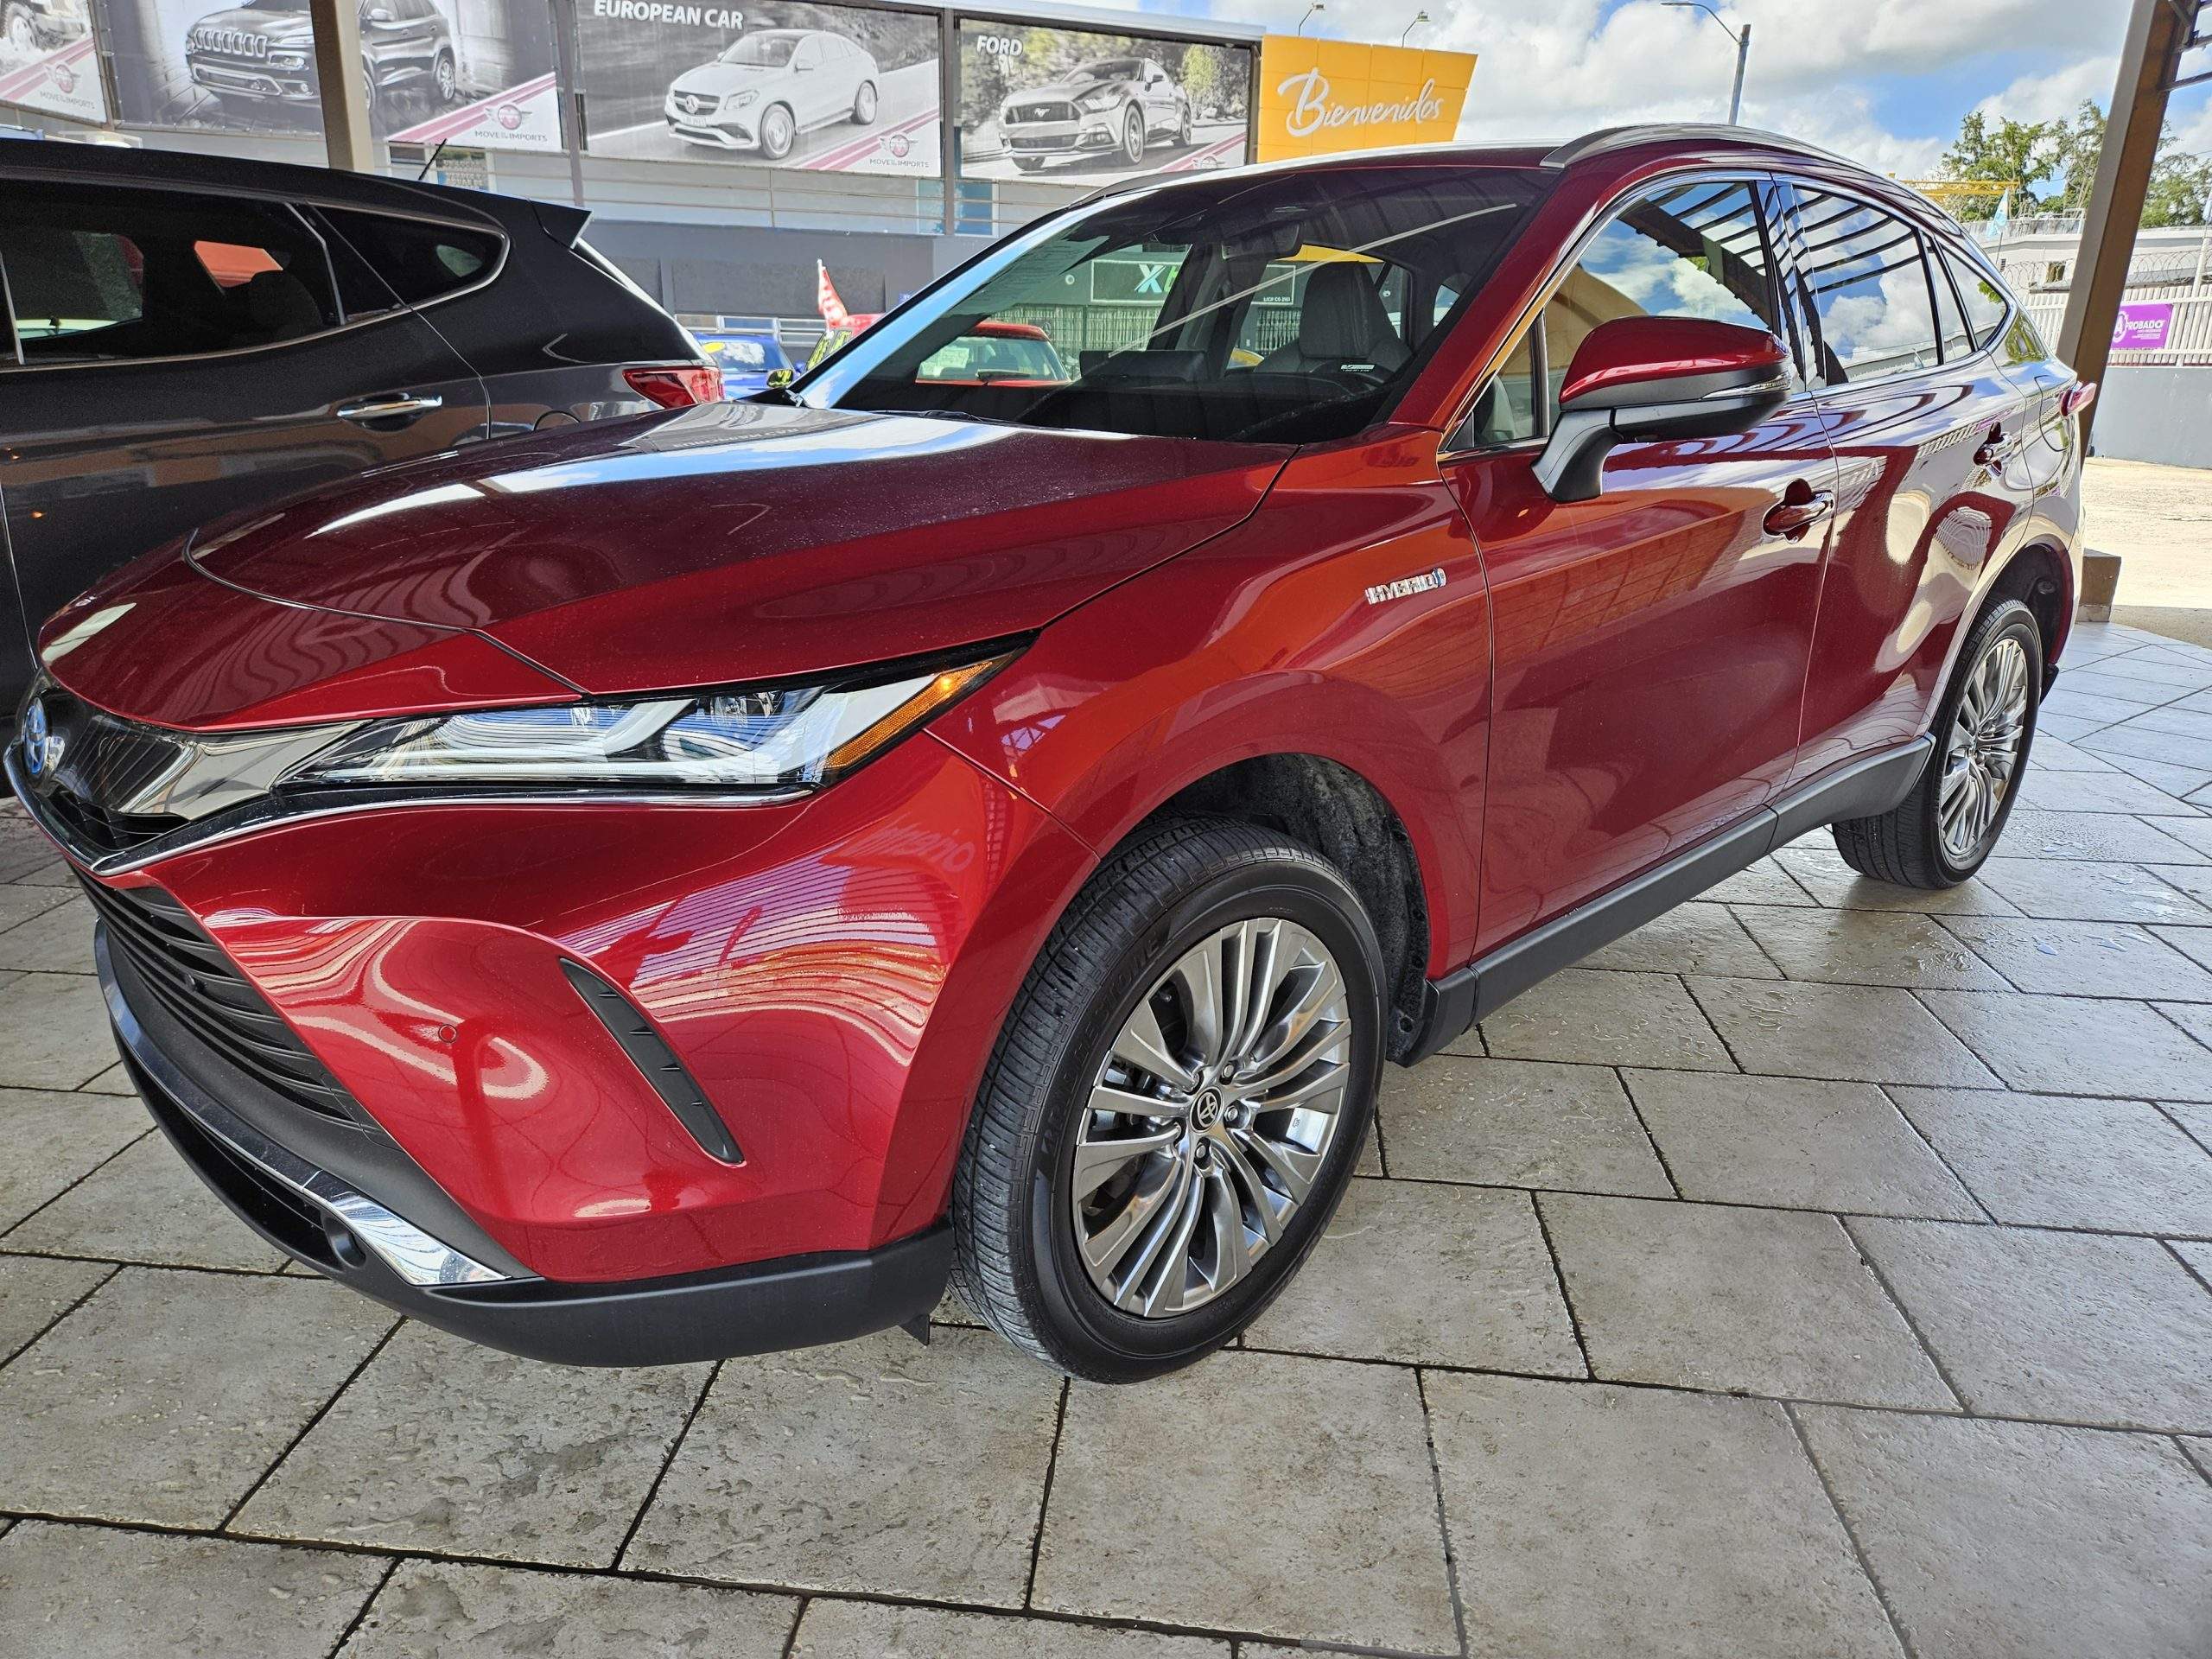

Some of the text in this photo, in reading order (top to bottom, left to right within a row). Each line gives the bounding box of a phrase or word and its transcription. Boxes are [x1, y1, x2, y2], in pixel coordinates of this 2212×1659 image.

[594, 0, 744, 30] EUROPEAN CAR
[976, 35, 1023, 56] FORD
[1277, 67, 1444, 137] Bienvenidos
[474, 130, 501, 139] MOVE
[509, 133, 548, 143] IMPORTS
[898, 160, 930, 168] IMPORTS
[1365, 570, 1442, 605] HYBRID
